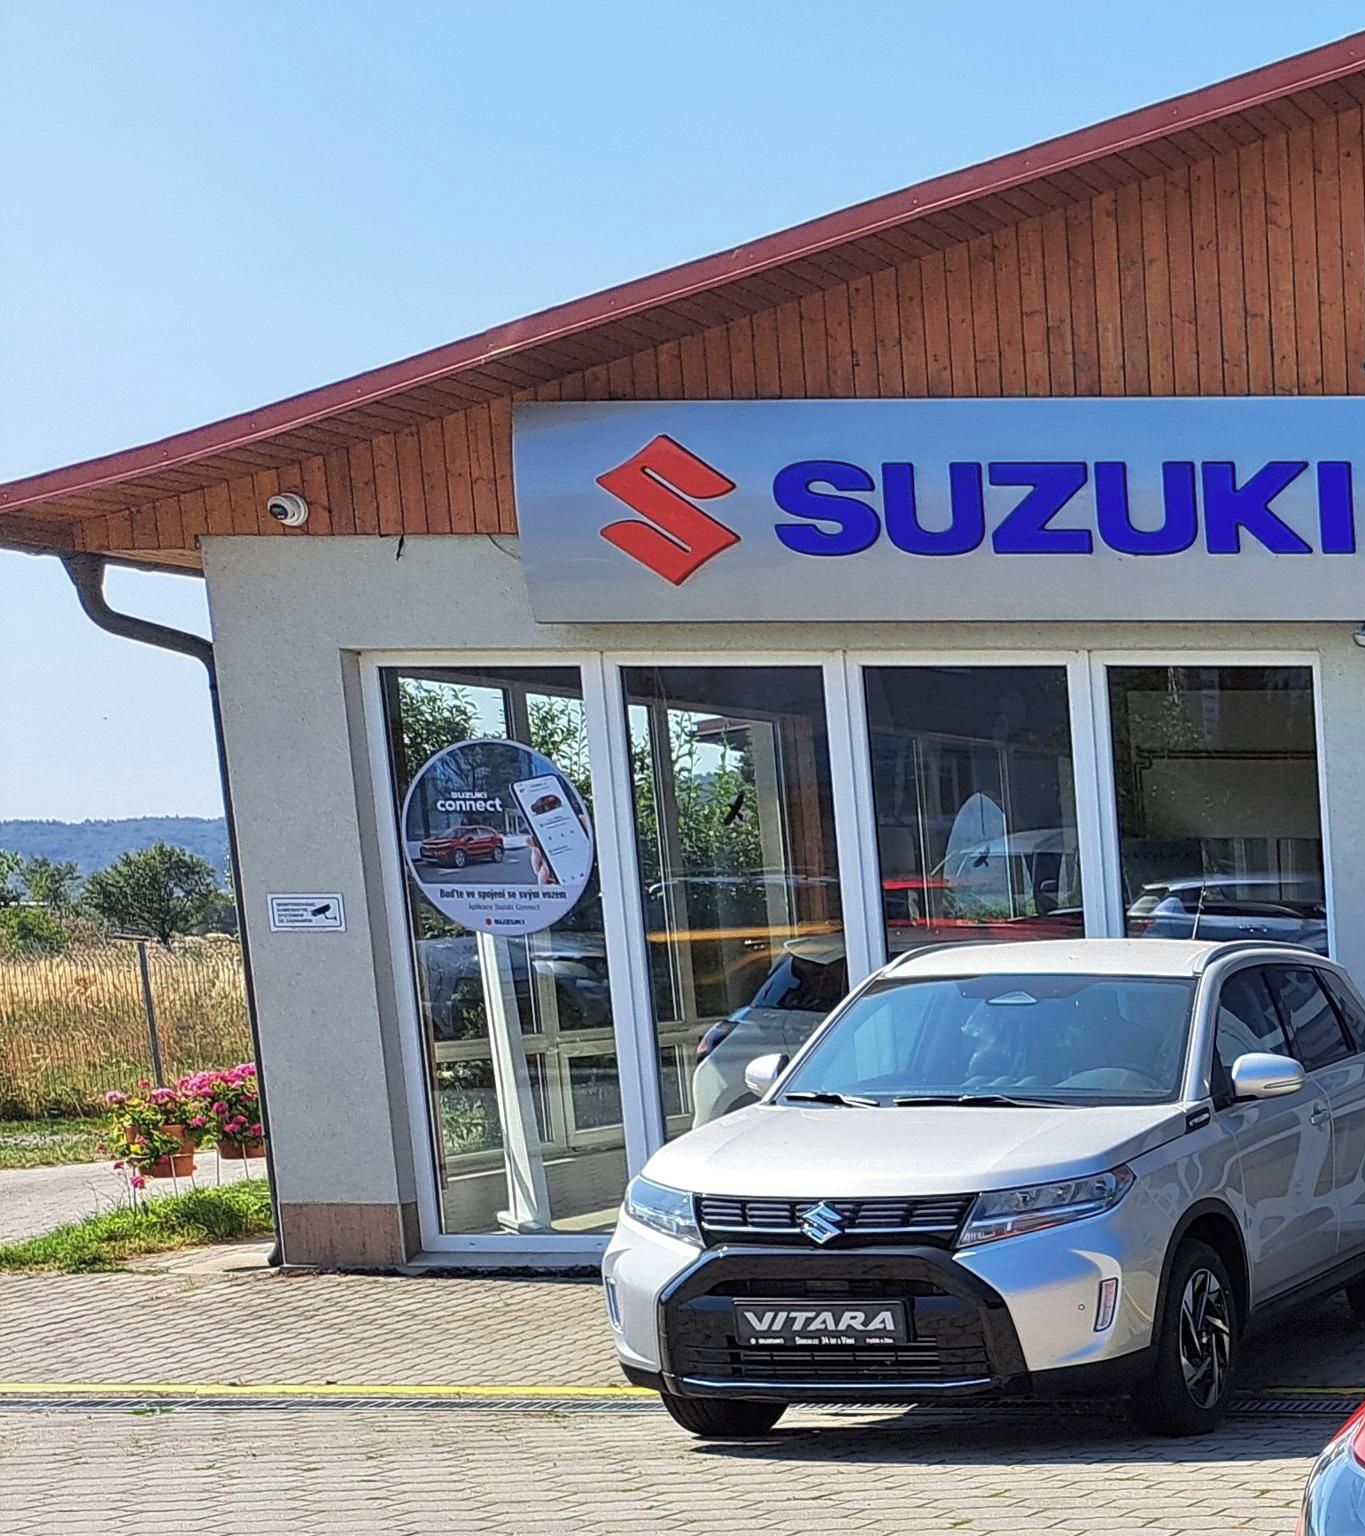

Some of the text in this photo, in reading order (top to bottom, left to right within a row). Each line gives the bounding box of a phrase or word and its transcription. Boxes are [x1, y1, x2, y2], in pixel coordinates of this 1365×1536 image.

[773, 459, 1357, 557] SUZUKI
[450, 791, 488, 799] SUZUKI
[436, 797, 503, 812] connect
[465, 891, 476, 899] ve
[477, 889, 506, 901] spojení
[507, 891, 518, 899] se
[518, 889, 540, 901] svým
[541, 890, 567, 899] vozem
[744, 1311, 896, 1331] VITARA
